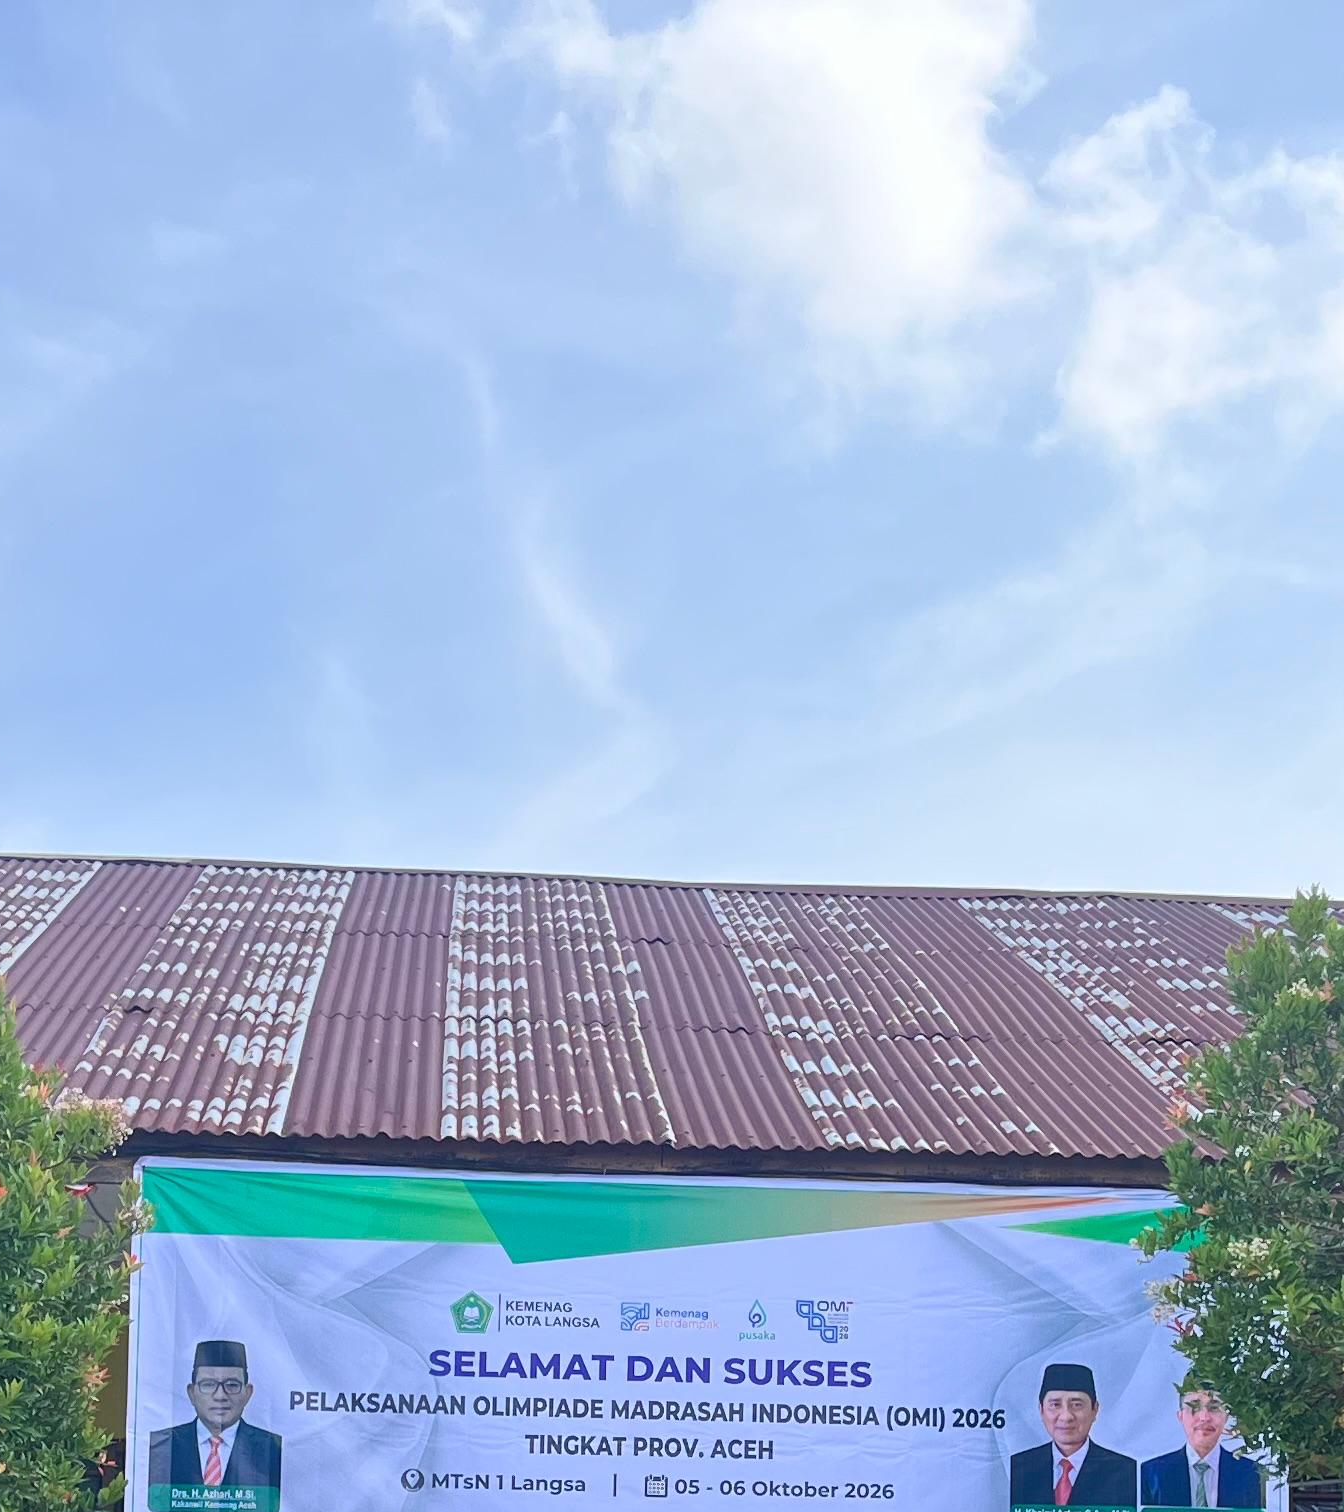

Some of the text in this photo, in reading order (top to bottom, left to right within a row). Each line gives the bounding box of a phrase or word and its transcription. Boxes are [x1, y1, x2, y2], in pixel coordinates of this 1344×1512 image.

[505, 1301, 573, 1314] KEMENAG
[656, 1307, 709, 1320] Kemenag
[505, 1315, 601, 1329] KOTA LANGSA
[656, 1318, 720, 1330] Berdampak
[739, 1331, 776, 1341] pusaka
[429, 1350, 872, 1388] SELAMAT DAN SUKSES
[289, 1390, 1006, 1432] PELAKSANAAN OLIMPIADE MADRASAH INDONESIA (OMI) 2026
[525, 1434, 774, 1460] TINGKAT PROV. ACEH
[431, 1473, 586, 1495] MTsN 1 Langsa
[674, 1479, 700, 1495] 05
[719, 1480, 746, 1496] 06
[752, 1480, 839, 1498] Oktober
[844, 1483, 895, 1499] 2026
[171, 1488, 190, 1499] Drs.
[192, 1489, 202, 1499] H.
[204, 1501, 237, 1510] Kemenag
[238, 1501, 257, 1509] Aceh
